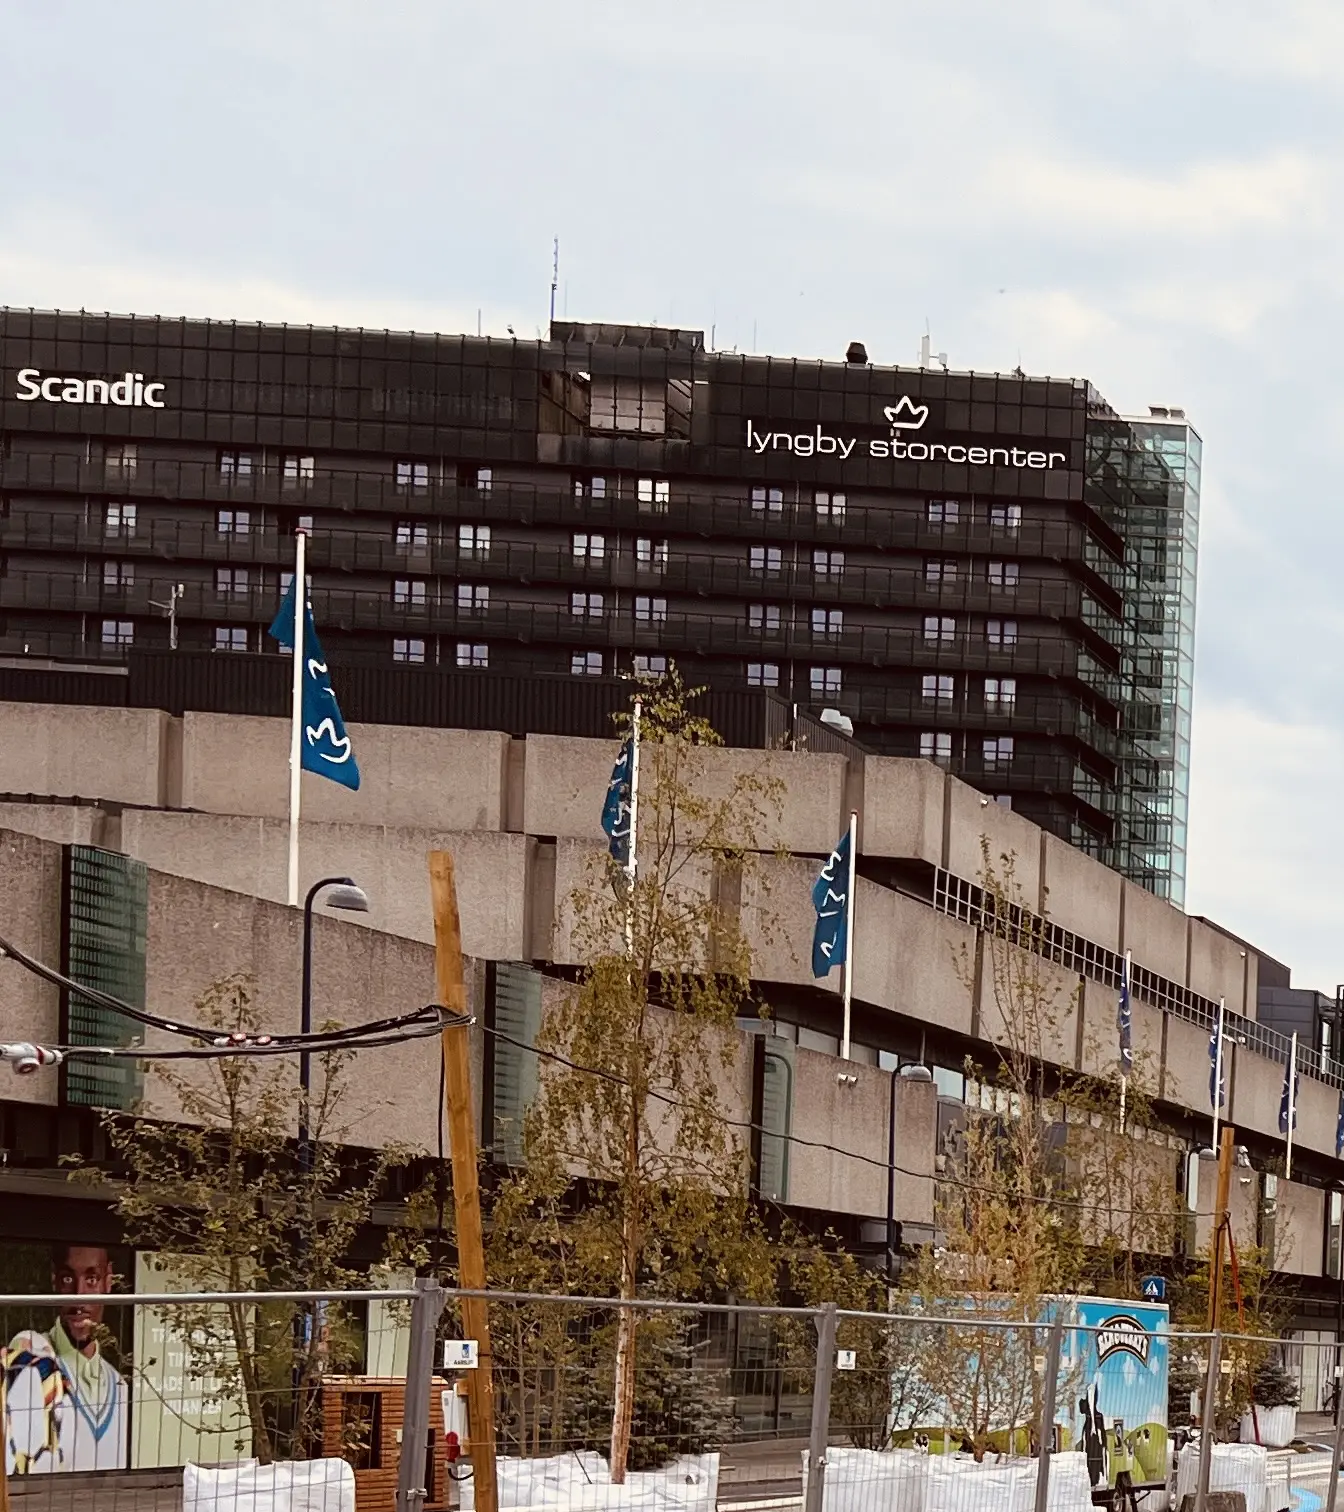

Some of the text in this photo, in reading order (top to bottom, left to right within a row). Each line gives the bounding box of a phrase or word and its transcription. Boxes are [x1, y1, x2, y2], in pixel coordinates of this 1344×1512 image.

[16, 368, 166, 408] Scandic
[746, 419, 1066, 469] lyngby storcenter
